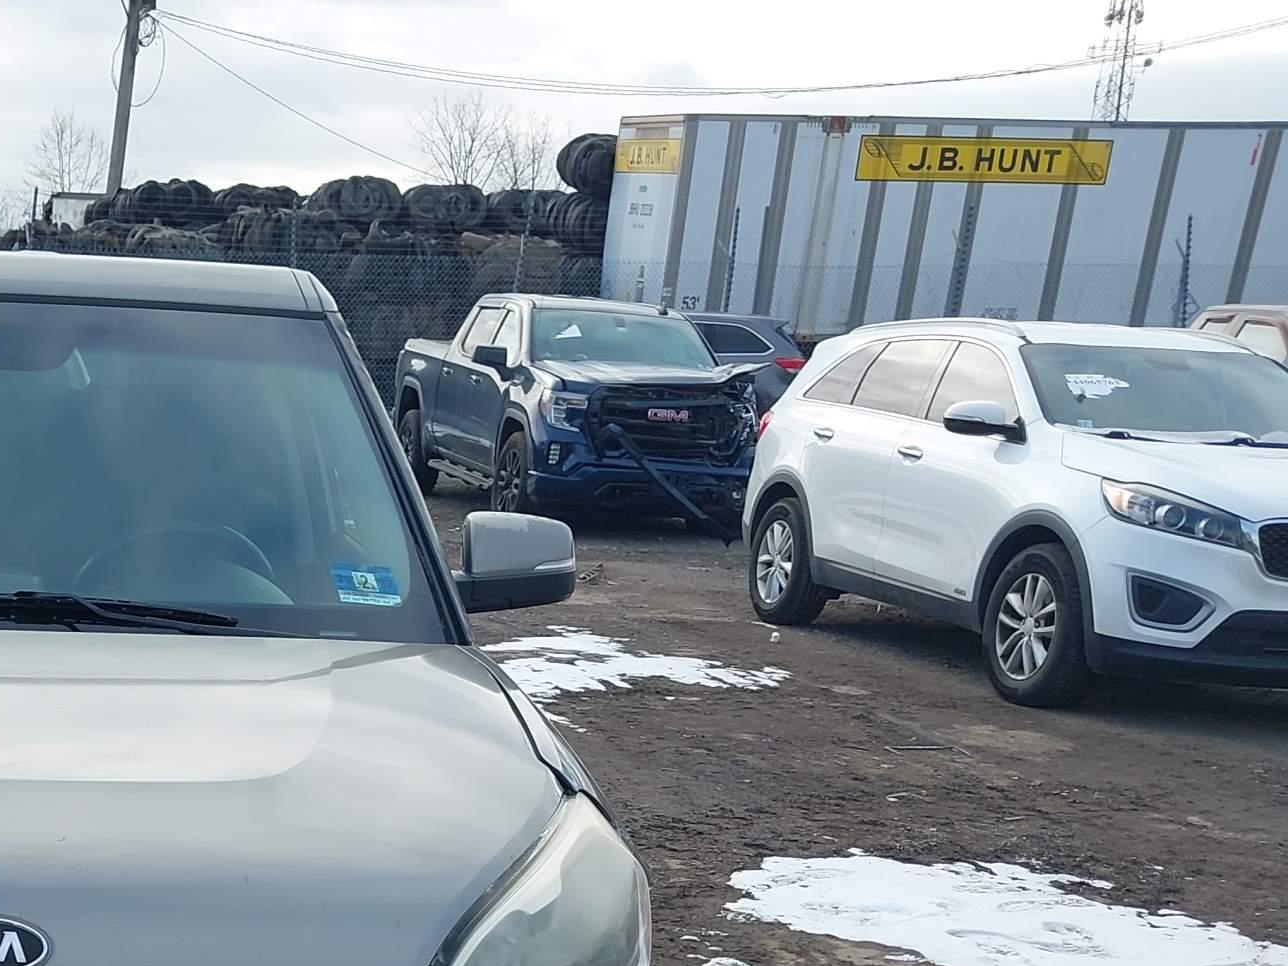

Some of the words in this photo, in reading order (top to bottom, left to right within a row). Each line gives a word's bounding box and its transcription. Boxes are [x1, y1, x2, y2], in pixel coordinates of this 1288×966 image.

[645, 147, 667, 165] HUNT
[907, 146, 964, 171] J.B.
[974, 147, 1062, 173] HUNT
[681, 296, 700, 310] 53'
